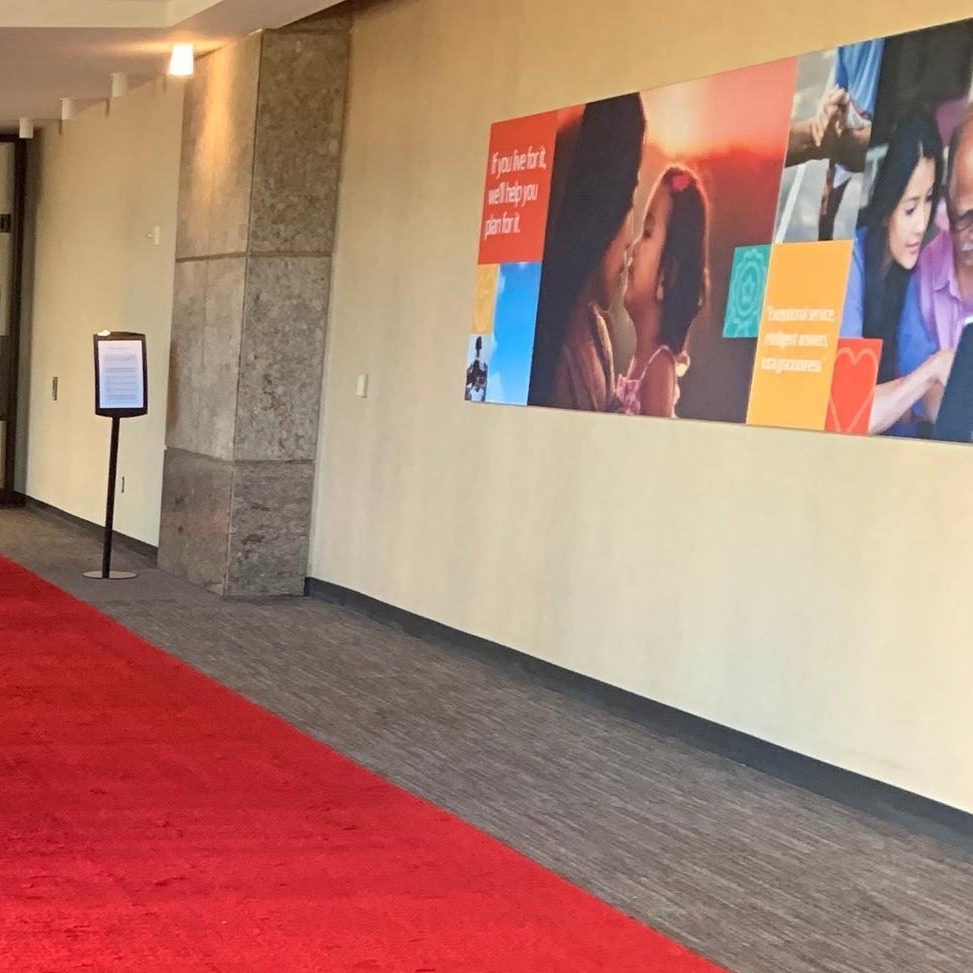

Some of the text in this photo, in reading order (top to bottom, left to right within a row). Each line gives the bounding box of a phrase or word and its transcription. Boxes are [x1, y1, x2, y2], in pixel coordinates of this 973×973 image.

[496, 156, 513, 180] you
[513, 148, 527, 172] live
[527, 145, 540, 169] for
[505, 179, 523, 207] help
[521, 183, 539, 207] you
[484, 211, 502, 241] plan
[502, 211, 514, 234] for
